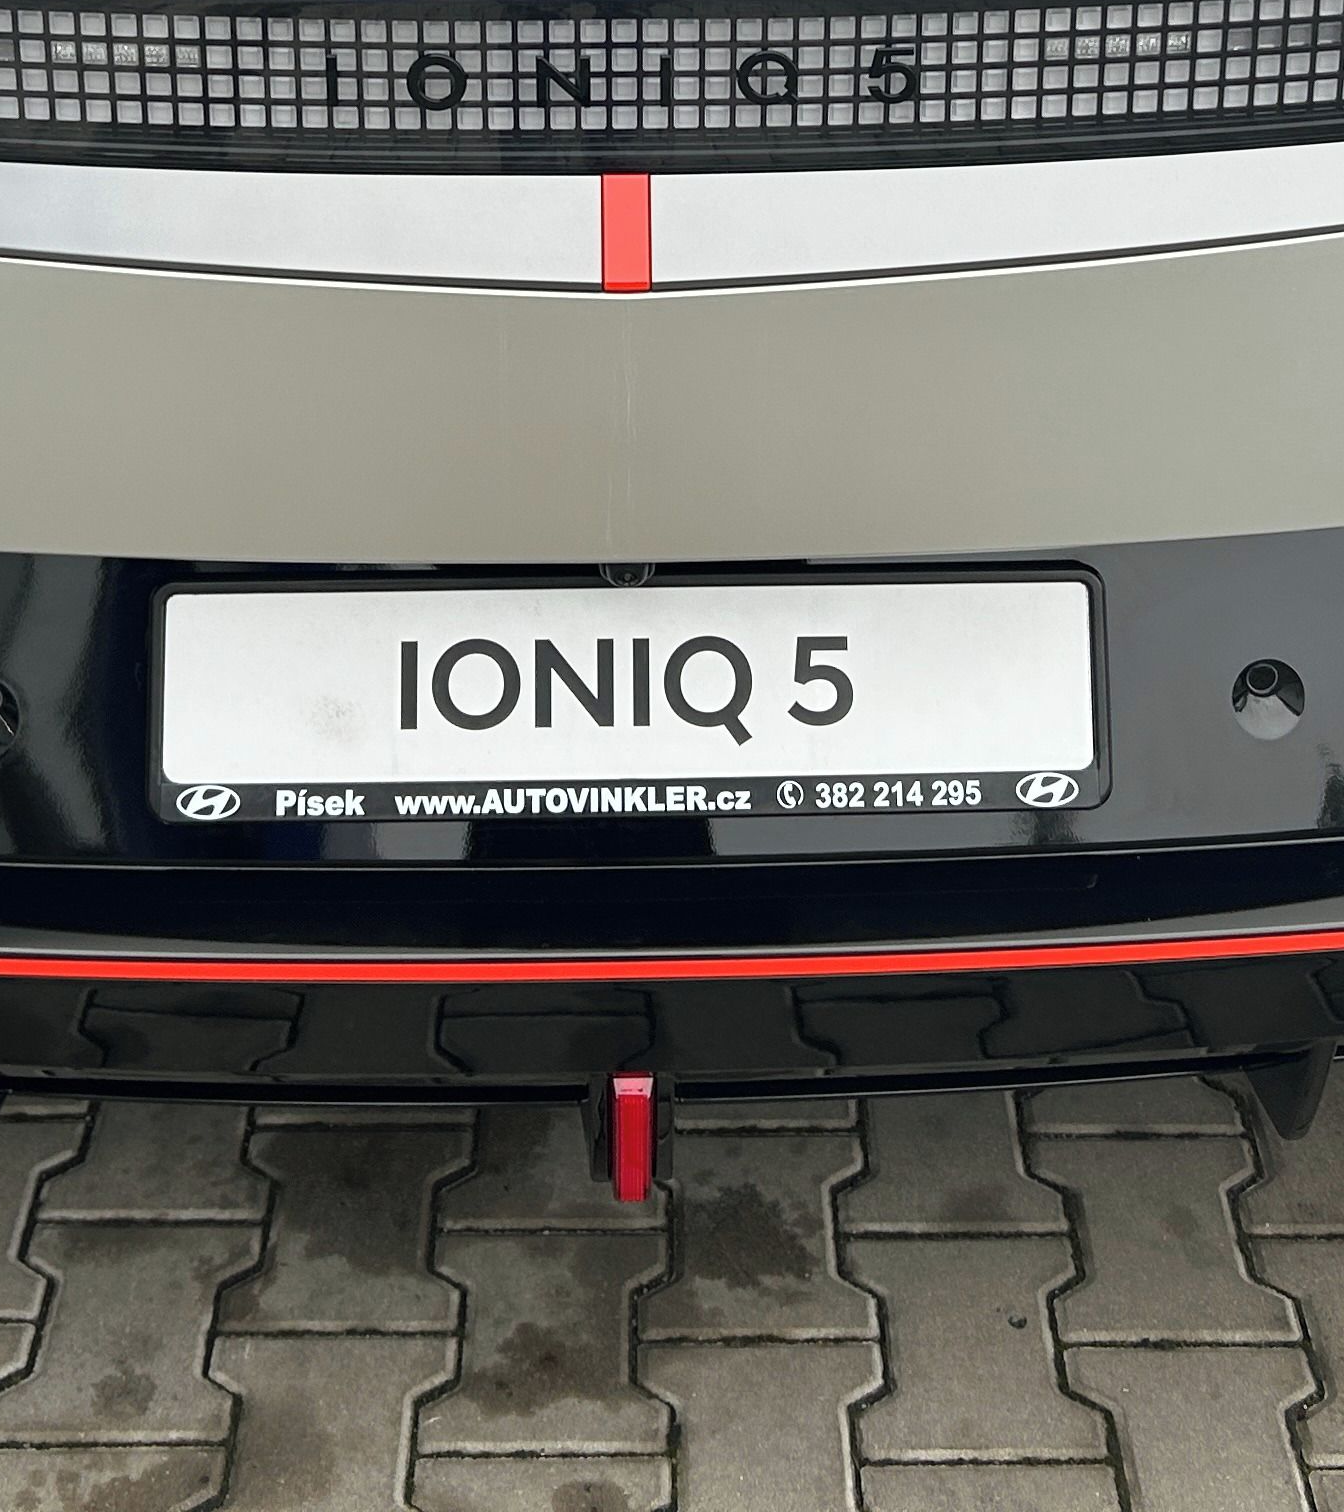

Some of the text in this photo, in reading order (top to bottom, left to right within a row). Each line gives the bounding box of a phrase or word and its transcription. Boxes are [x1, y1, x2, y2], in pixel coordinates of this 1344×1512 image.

[325, 47, 917, 110] IONIQ 5
[400, 635, 854, 746] IONIQ 5
[275, 779, 982, 817] Písek www.AUTOVINKLER.cz 382 214 295
